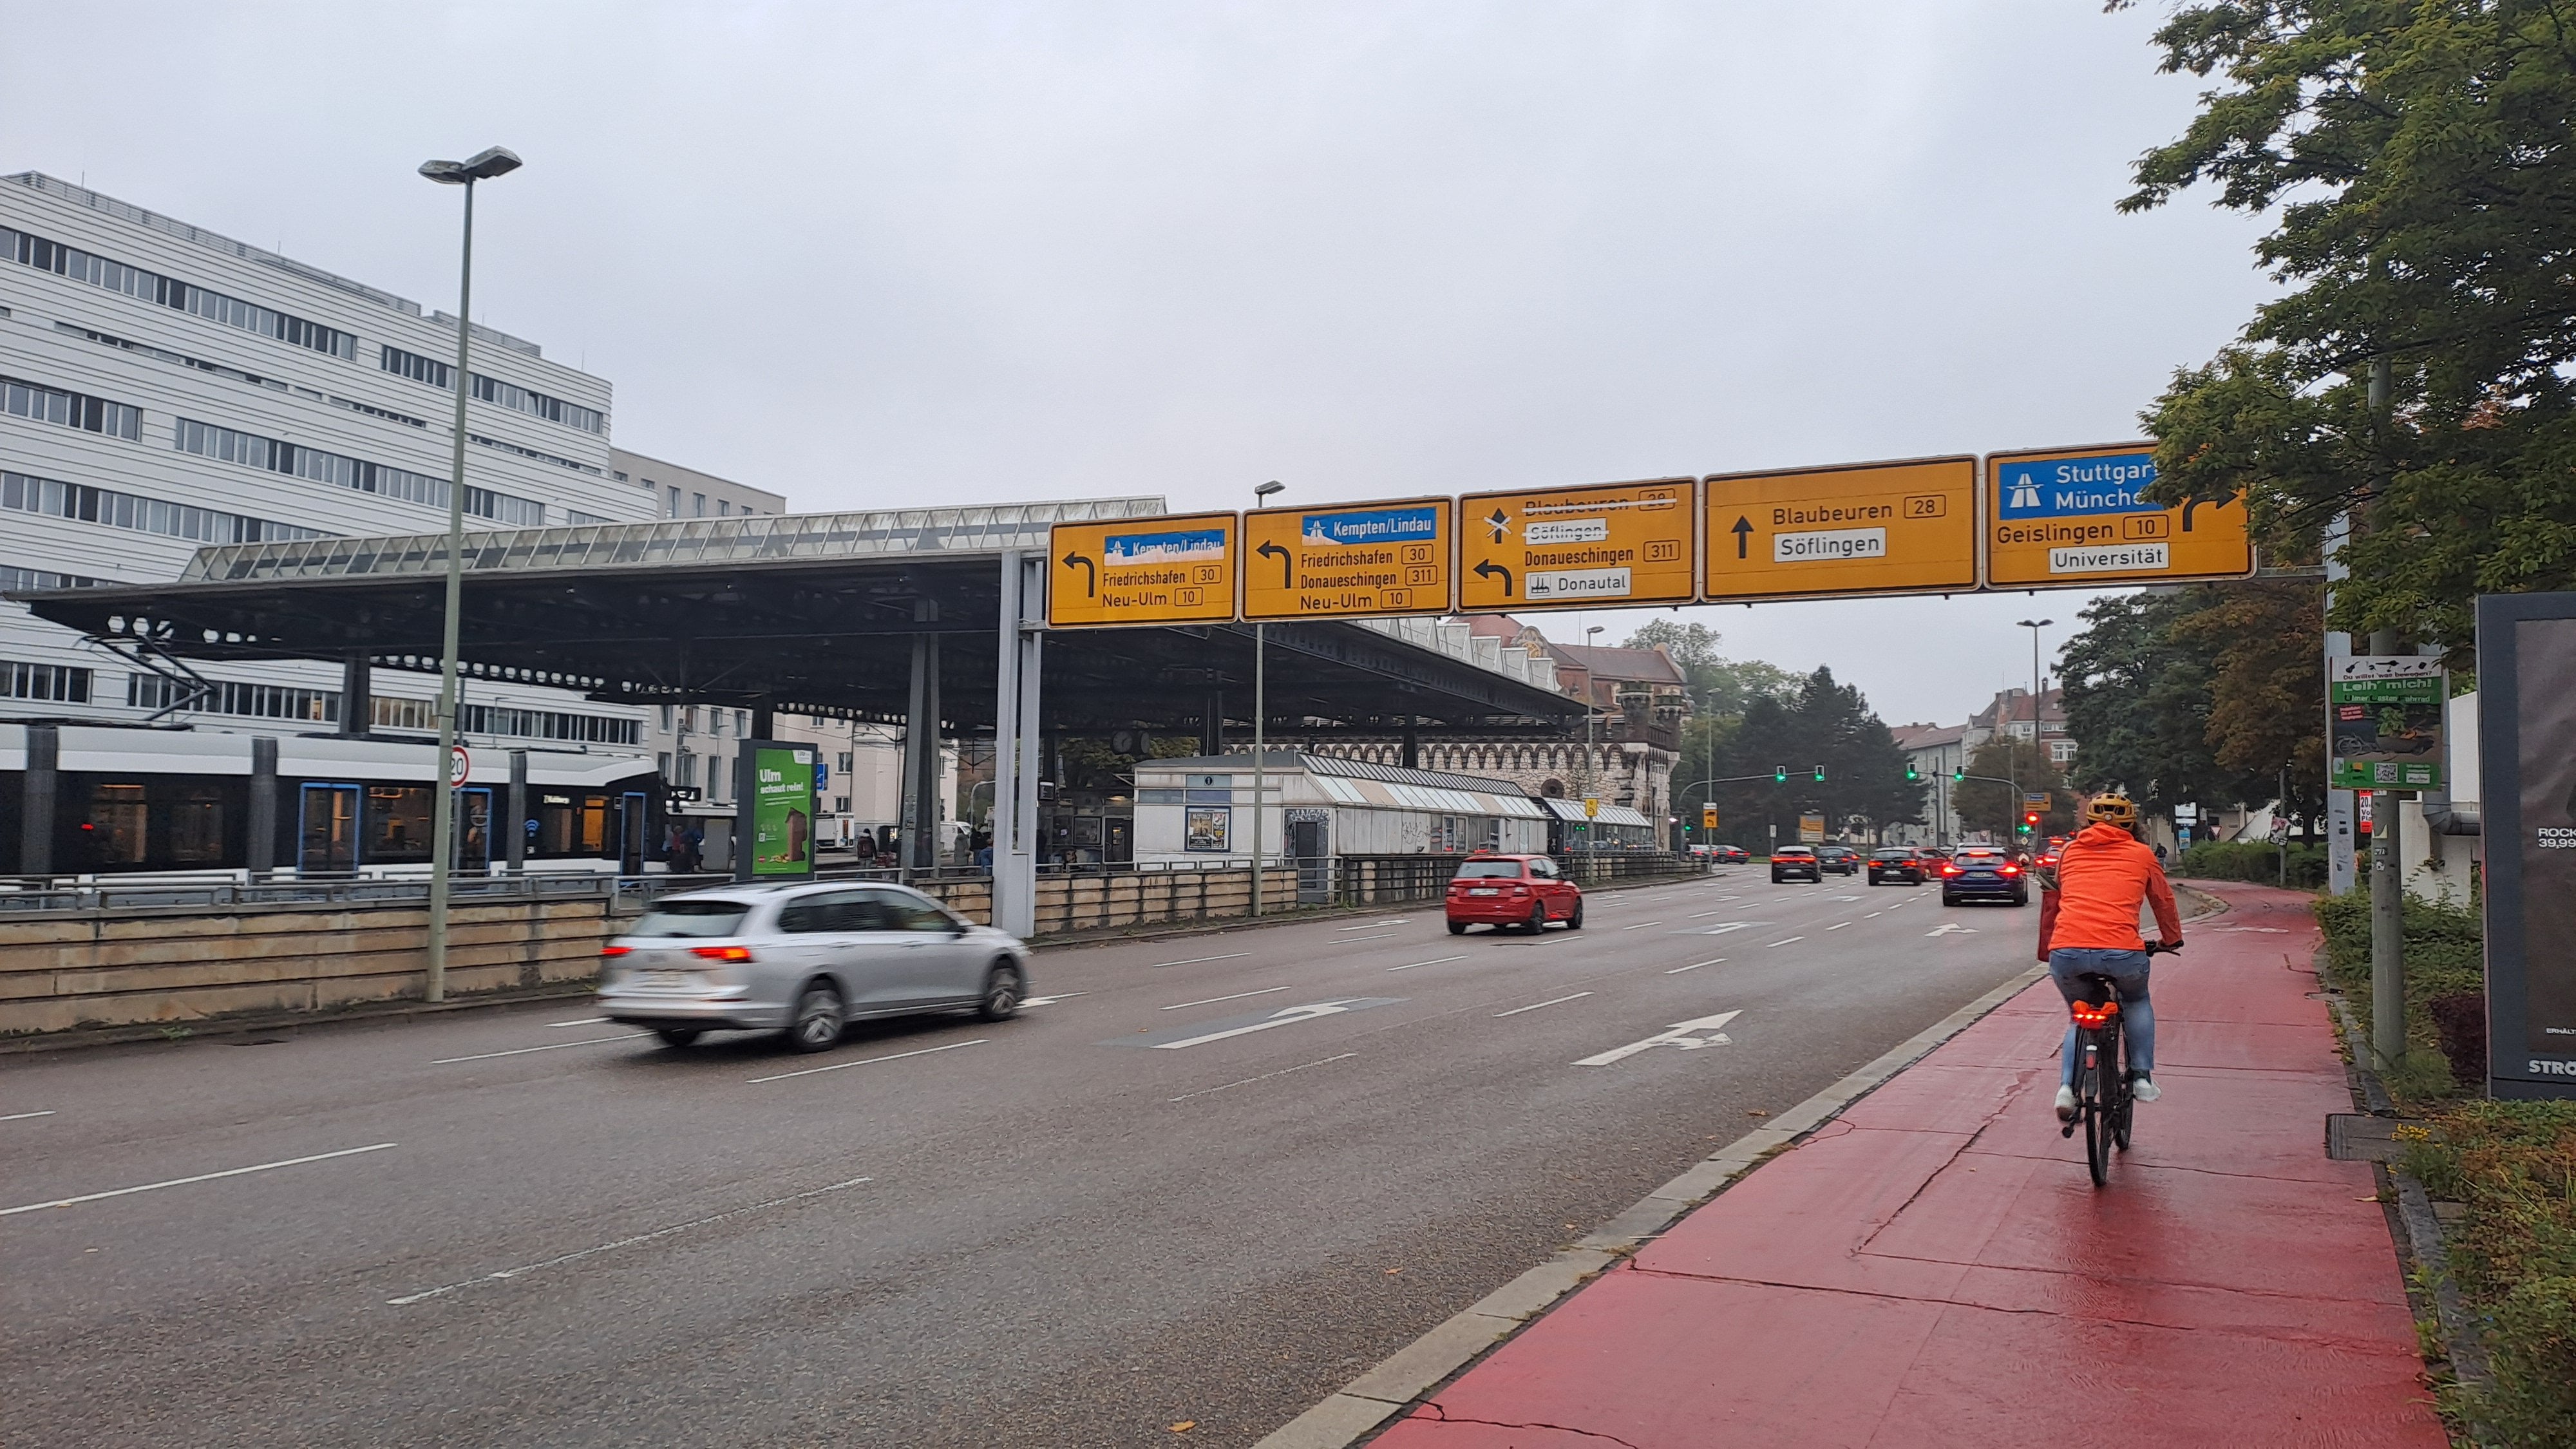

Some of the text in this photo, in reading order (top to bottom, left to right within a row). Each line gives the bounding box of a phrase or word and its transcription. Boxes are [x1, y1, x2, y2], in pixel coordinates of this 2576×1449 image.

[1525, 498, 1629, 516] Blaubeuren
[2056, 488, 2146, 510] Münche
[1773, 499, 1936, 525] Blaubeuren 28
[1334, 516, 1432, 539] Kempten/Lindau
[1530, 524, 1602, 541] Söflingen
[1997, 519, 2155, 544] Geislingen 10
[1525, 544, 1673, 567] Donaueschingen 311
[1780, 536, 1879, 557] Söflingen
[1301, 547, 1425, 569] Friedrichshafen 30
[2055, 548, 2163, 568] Universität
[1103, 568, 1215, 587] Friedrichshafen 30
[1301, 569, 1432, 589] Donaueschingen 311
[1558, 574, 1626, 591] Donautal
[1103, 590, 1195, 608] Neu-Ulm 10
[1300, 592, 1403, 611] Neu-Ulm 10
[2386, 678, 2432, 690] mich!
[451, 757, 464, 775] 20
[759, 768, 781, 783] Ulm
[760, 783, 786, 794] schaut
[2538, 828, 2576, 837] ROCK
[2538, 838, 2576, 849] 39,99
